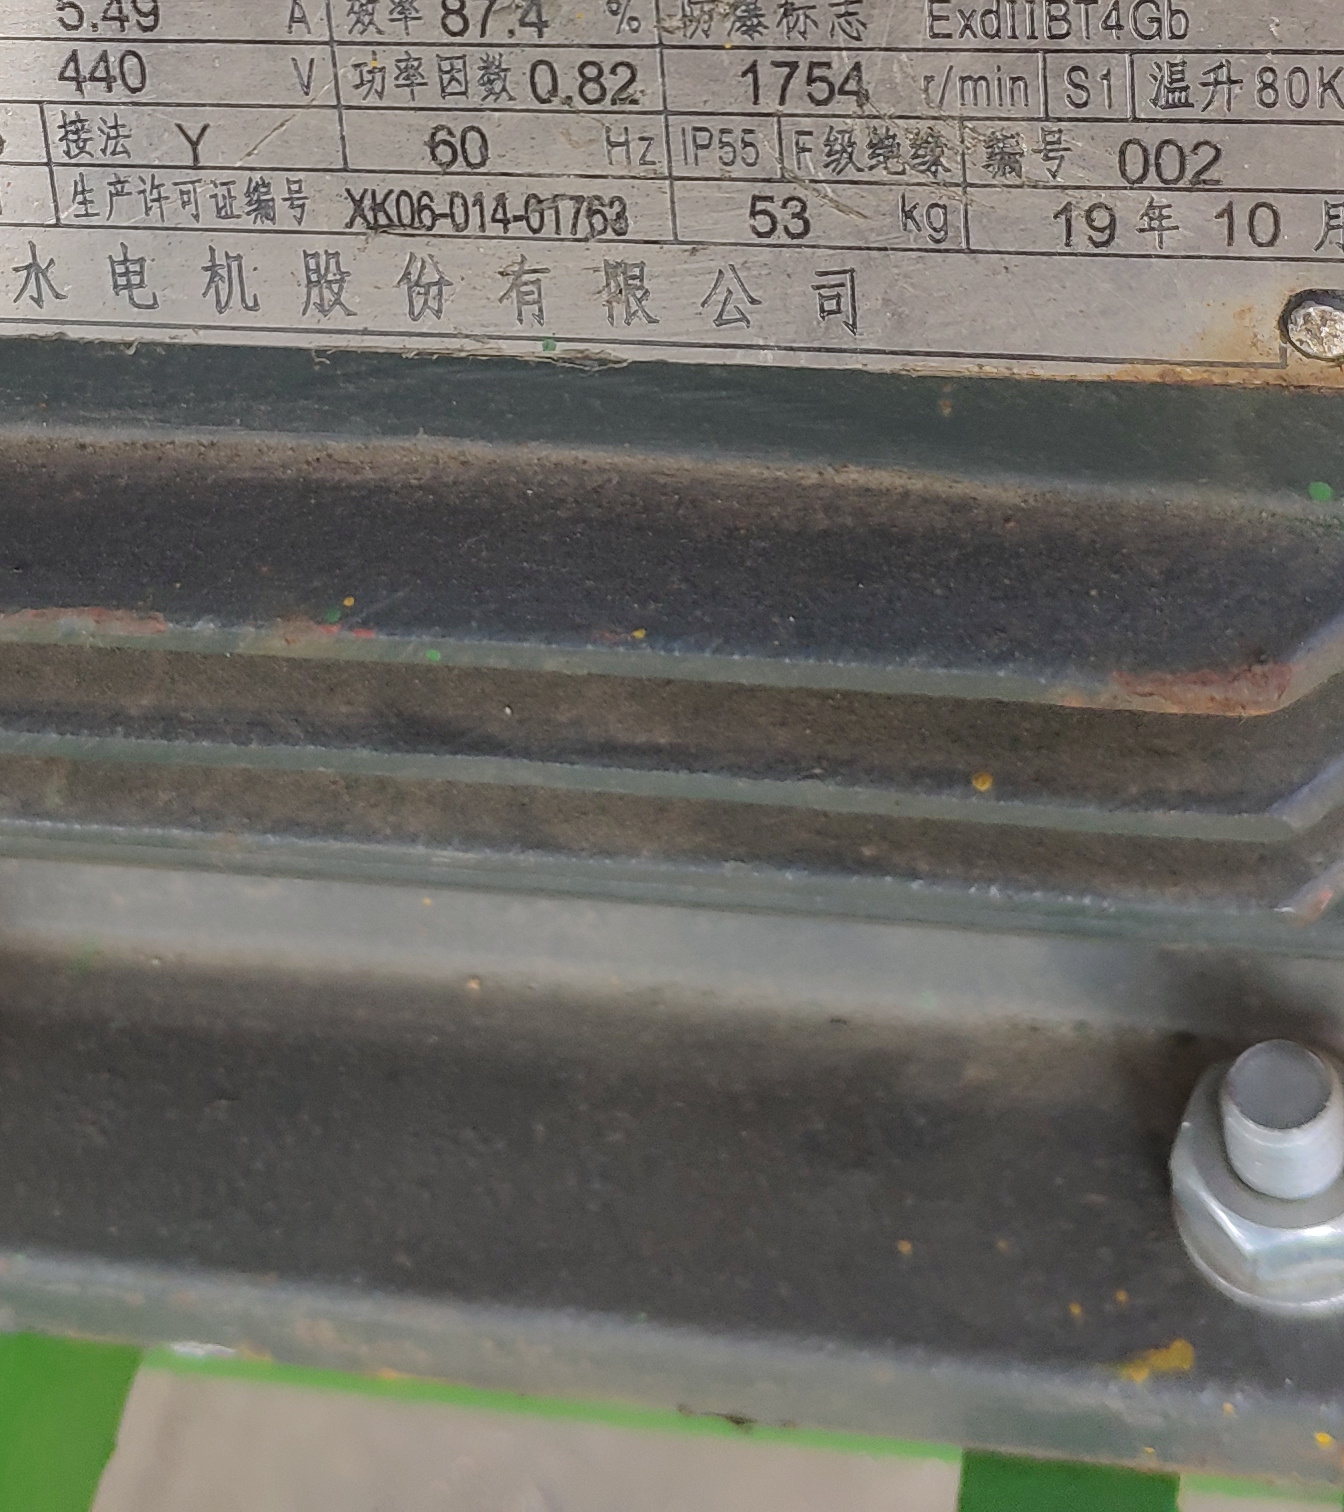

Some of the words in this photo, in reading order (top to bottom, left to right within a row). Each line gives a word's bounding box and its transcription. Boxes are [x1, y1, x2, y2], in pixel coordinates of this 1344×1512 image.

[56, 48, 148, 95] 440
[289, 56, 316, 97] V
[352, 49, 517, 104] 功率因数
[528, 58, 641, 107] 0.82
[739, 59, 870, 108] 1754
[922, 64, 1031, 111] r/min
[1065, 70, 1114, 110] S1
[57, 109, 133, 162] 接法
[173, 121, 211, 167] Y
[425, 123, 490, 171] 60
[603, 125, 657, 167] Hz
[680, 126, 760, 168] IP55
[981, 125, 1074, 181] 编号
[1117, 137, 1224, 187] 002
[72, 172, 314, 227] 生产许可证编号
[344, 187, 630, 237] XK06-014-01763
[748, 193, 811, 240] 53
[898, 191, 949, 245] kg
